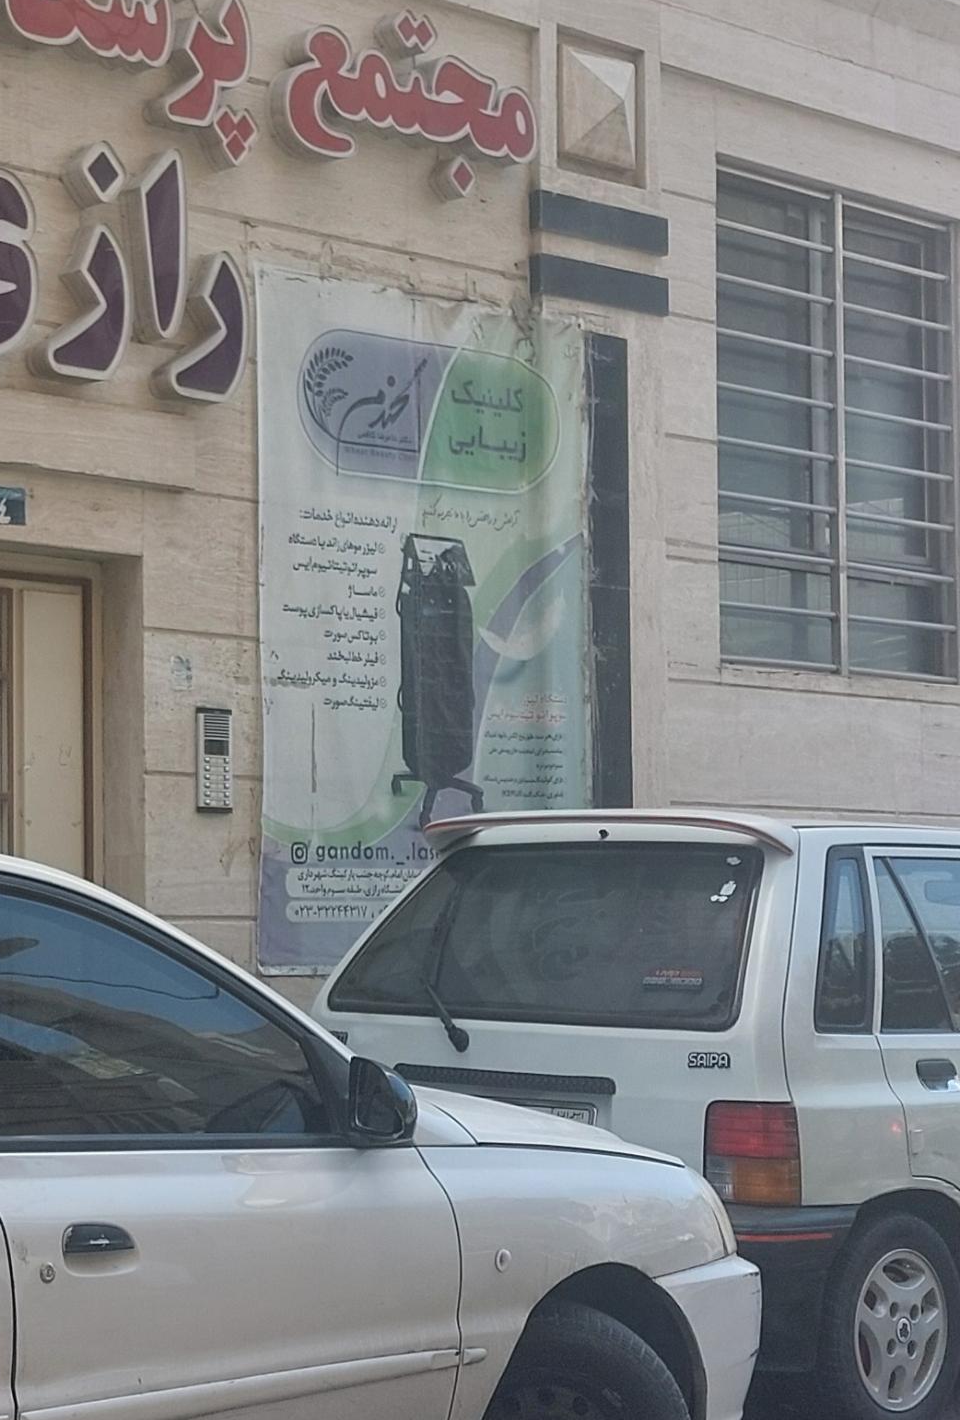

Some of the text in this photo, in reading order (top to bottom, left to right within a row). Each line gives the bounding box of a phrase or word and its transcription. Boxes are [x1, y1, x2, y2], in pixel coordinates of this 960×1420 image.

[280, 9, 537, 199] مجتمع
[450, 380, 525, 416] کلینیک
[448, 425, 527, 463] زیبایی
[688, 1052, 730, 1069] SAIPA
